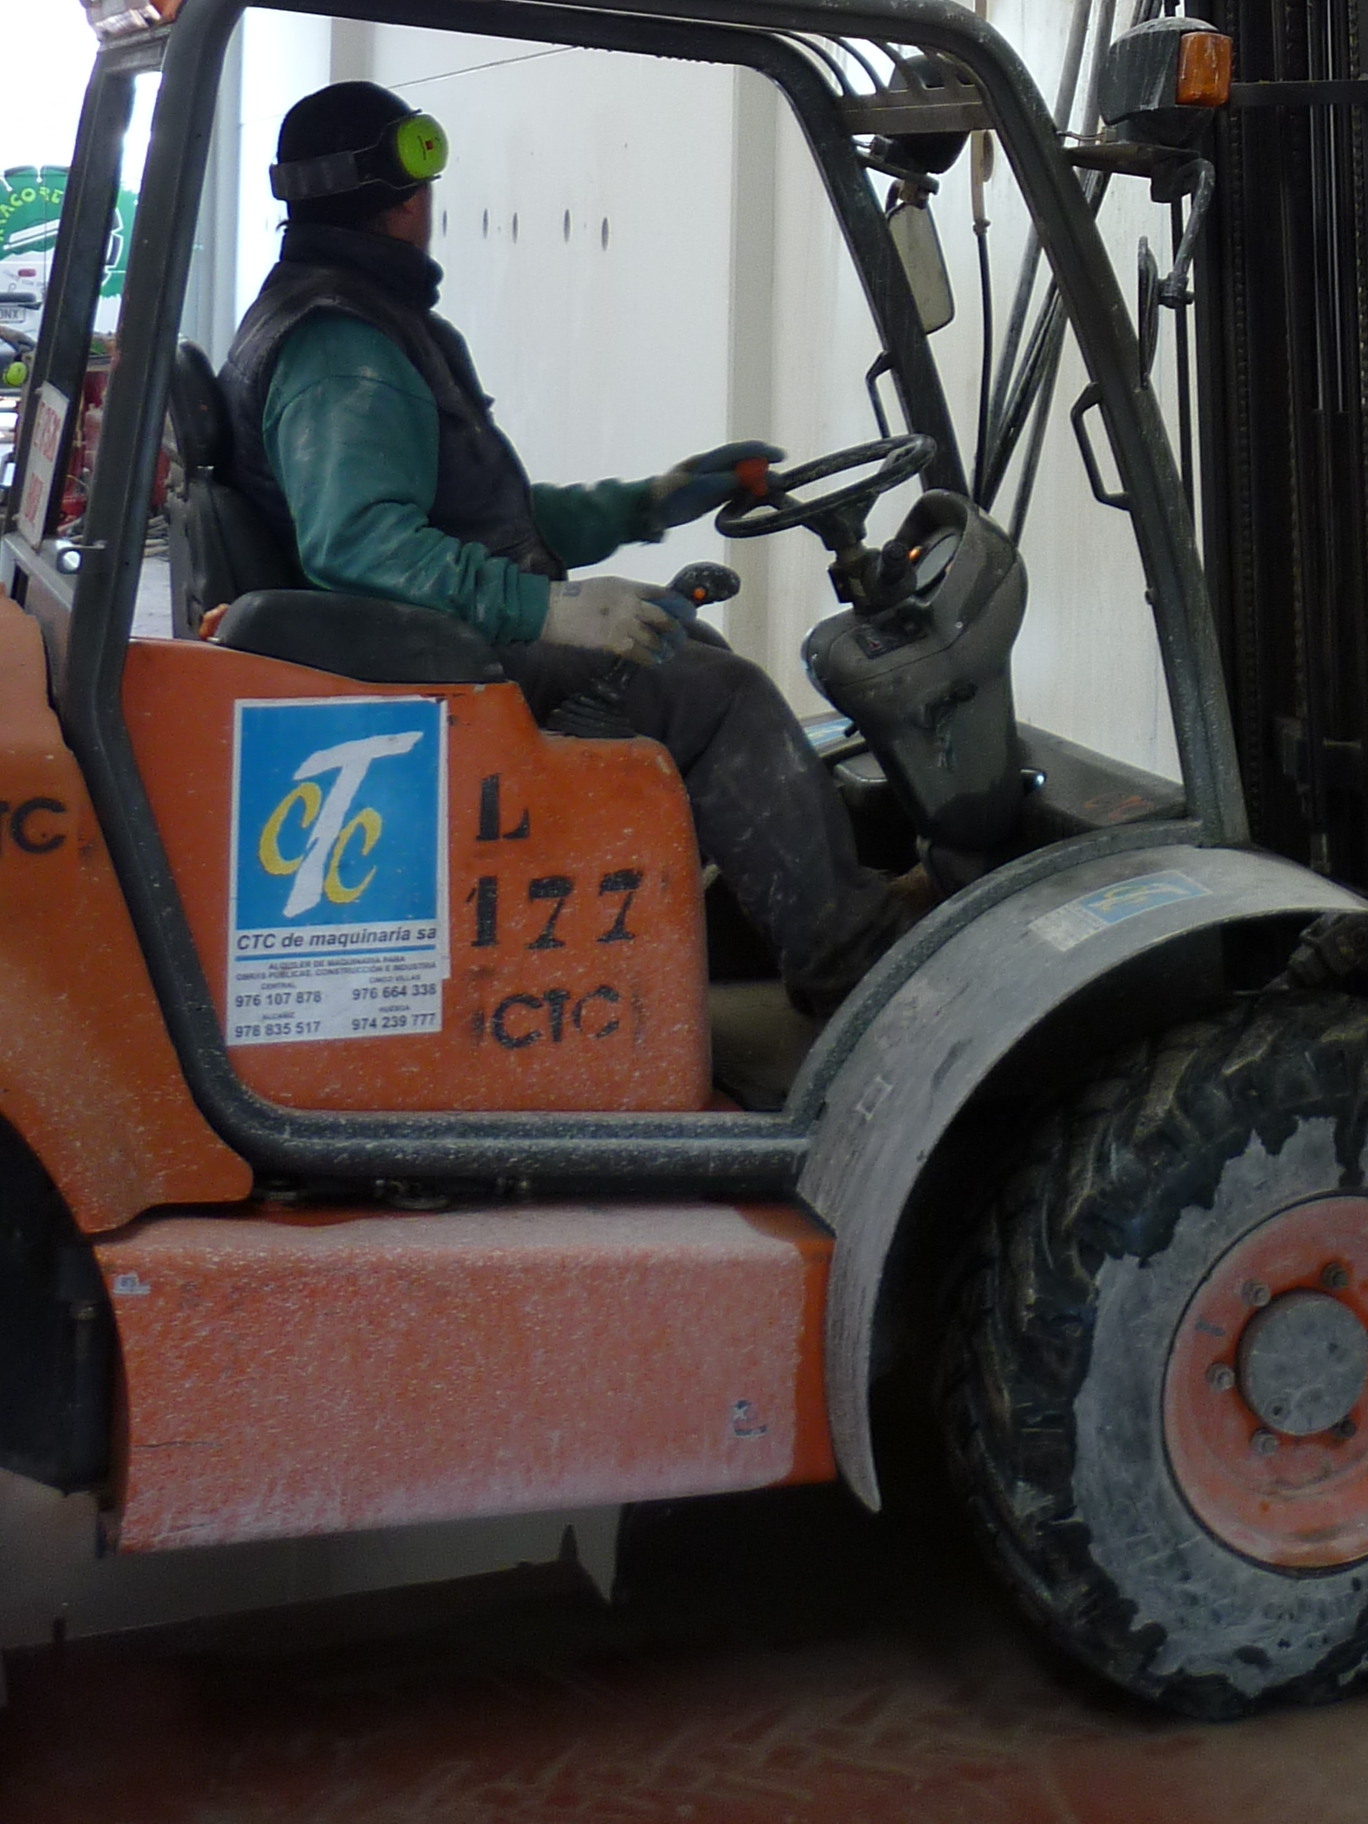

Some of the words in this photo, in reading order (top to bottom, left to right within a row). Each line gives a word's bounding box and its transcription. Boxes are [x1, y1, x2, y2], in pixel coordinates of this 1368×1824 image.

[475, 772, 531, 841] L
[258, 731, 424, 918] CTC
[236, 933, 276, 951] CTC
[281, 933, 304, 947] de
[309, 926, 411, 948] maquinaria
[416, 927, 437, 940] sa
[313, 959, 324, 968] DE
[235, 994, 262, 1008] 976
[266, 993, 292, 1006] 107
[295, 991, 322, 1004] 878
[351, 987, 378, 1001] 976
[382, 985, 407, 998] 664
[411, 983, 437, 996] 338
[351, 1018, 377, 1031] 974
[382, 1015, 407, 1028] 239
[411, 1013, 437, 1026] 777
[490, 984, 621, 1050] CTC
[235, 1024, 261, 1038] 978
[264, 1022, 292, 1036] 835
[295, 1020, 321, 1034] 517
